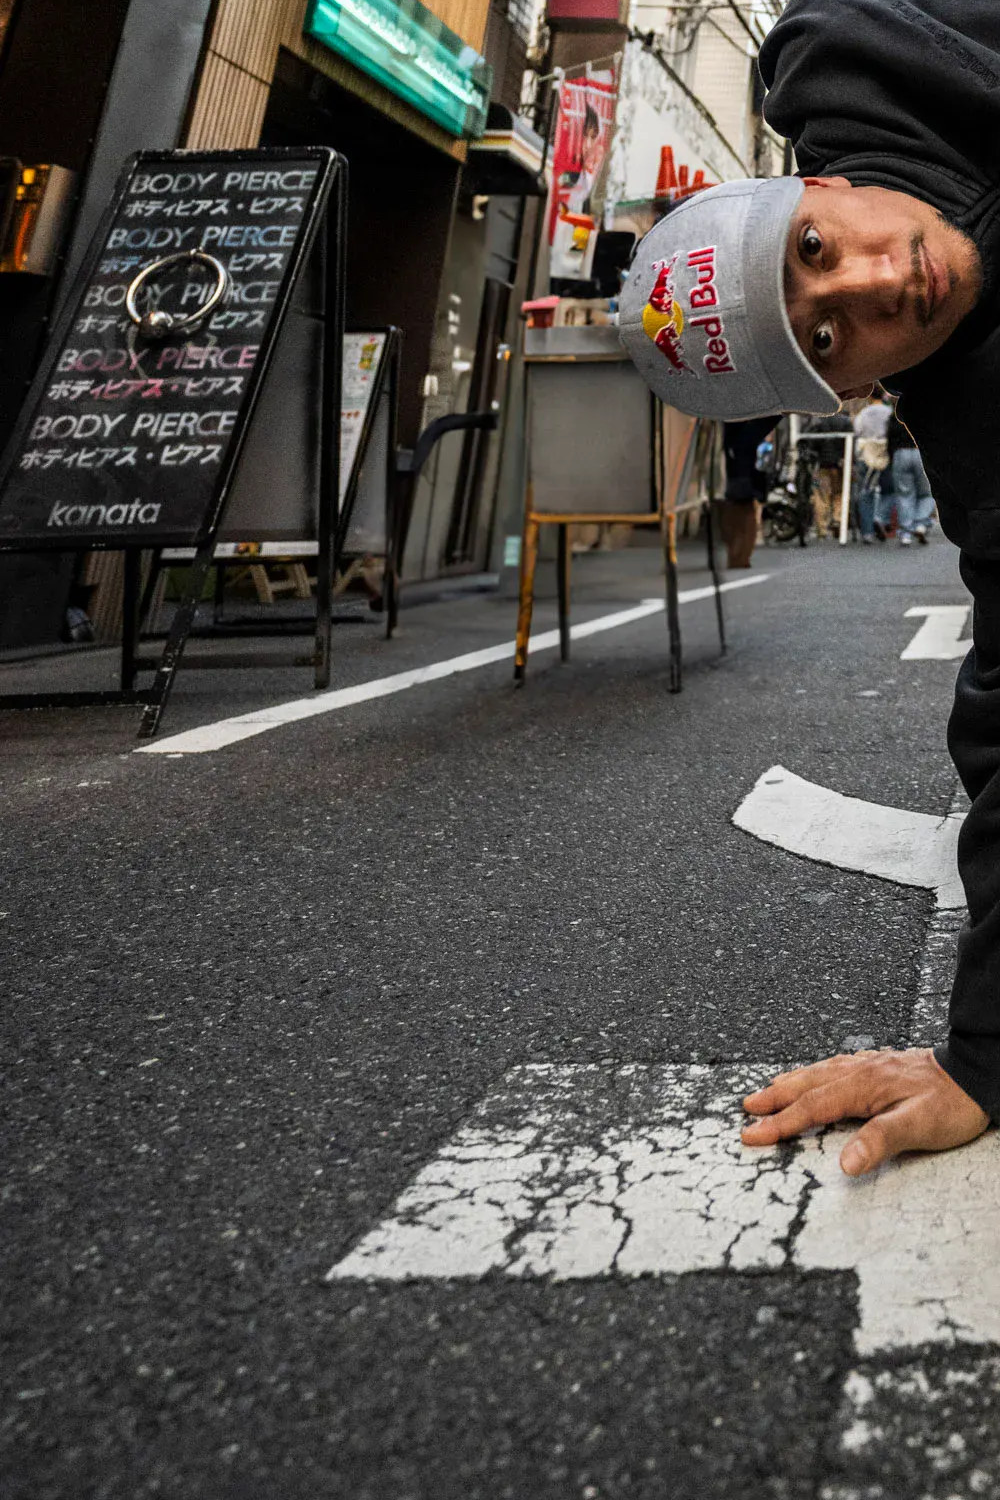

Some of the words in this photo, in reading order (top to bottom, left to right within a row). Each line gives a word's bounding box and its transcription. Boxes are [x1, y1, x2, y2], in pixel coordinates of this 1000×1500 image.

[130, 171, 218, 194] BODY
[222, 169, 318, 192] PIERCE
[106, 226, 197, 250] BODY
[201, 225, 300, 248] PIERCE
[686, 245, 721, 310] Bull
[56, 348, 150, 372] BODY
[156, 344, 260, 370] PIERCE
[688, 313, 738, 375] Red
[29, 413, 127, 440] BODY
[130, 410, 239, 437] PIERCE
[47, 498, 162, 527] kanata
